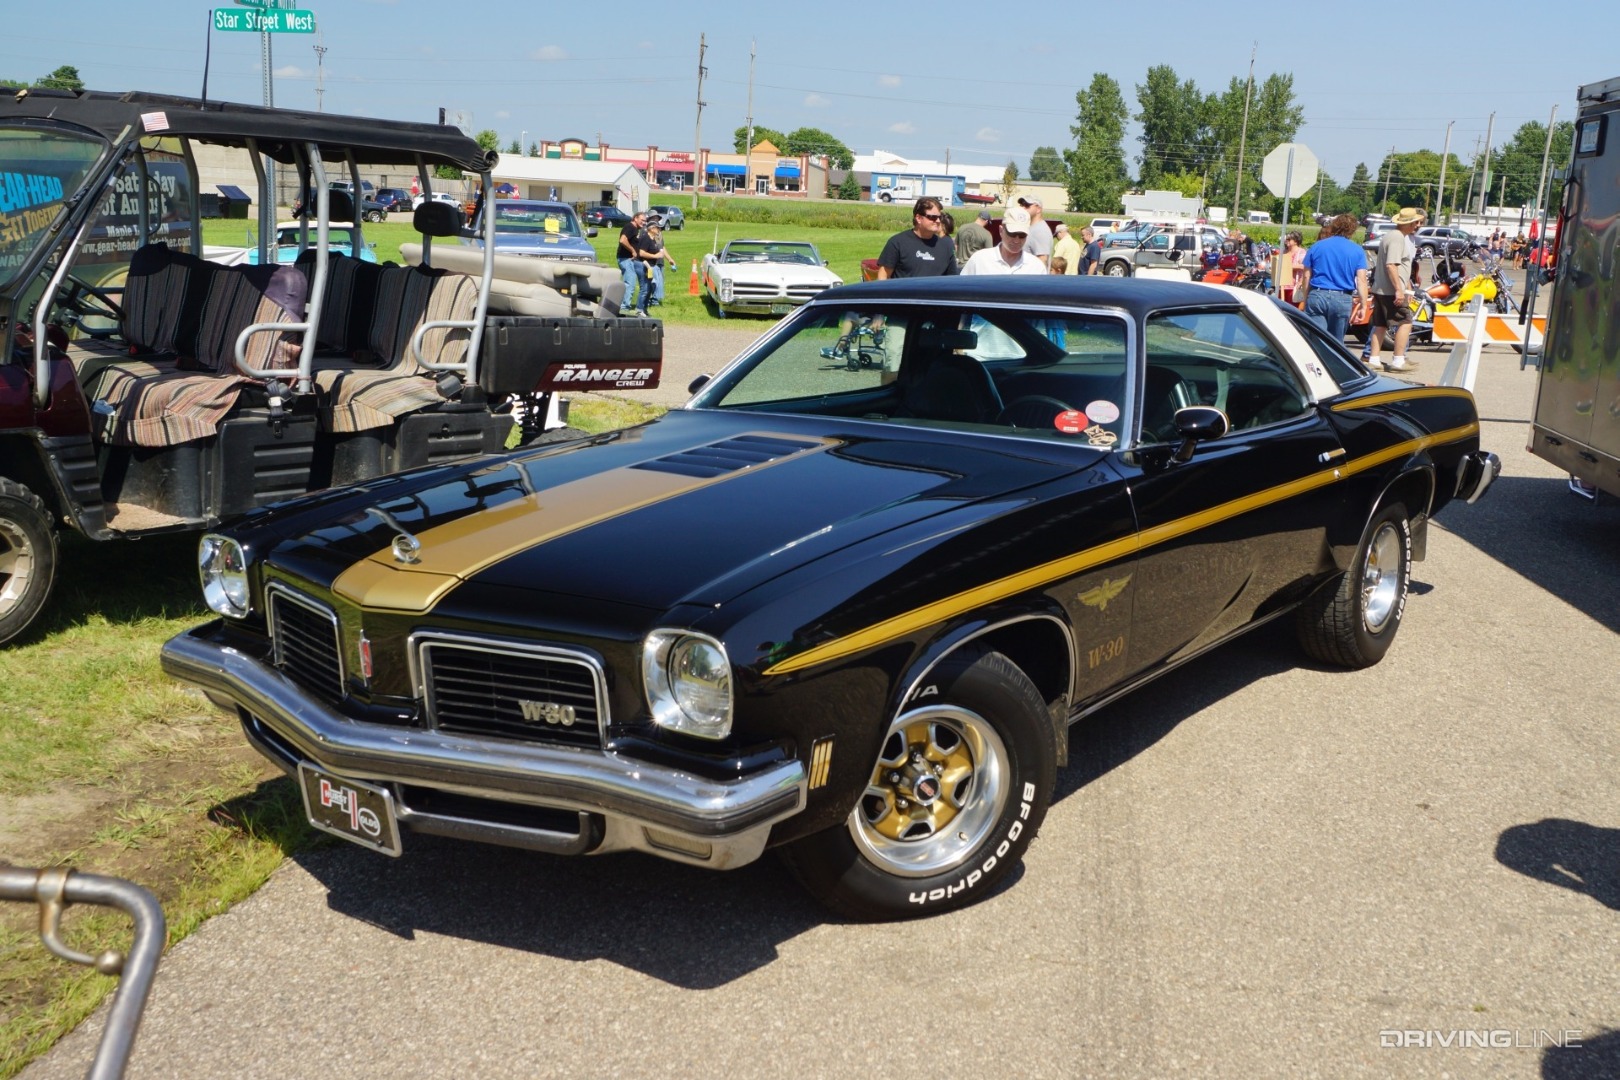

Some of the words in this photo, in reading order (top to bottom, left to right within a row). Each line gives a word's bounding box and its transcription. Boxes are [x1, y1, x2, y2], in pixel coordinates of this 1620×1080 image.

[216, 11, 239, 28] Star
[245, 11, 279, 30] Street
[286, 13, 313, 30] West
[0, 172, 64, 213] EAR-HEAD
[105, 225, 133, 240] Maple
[552, 368, 654, 382] RANGER
